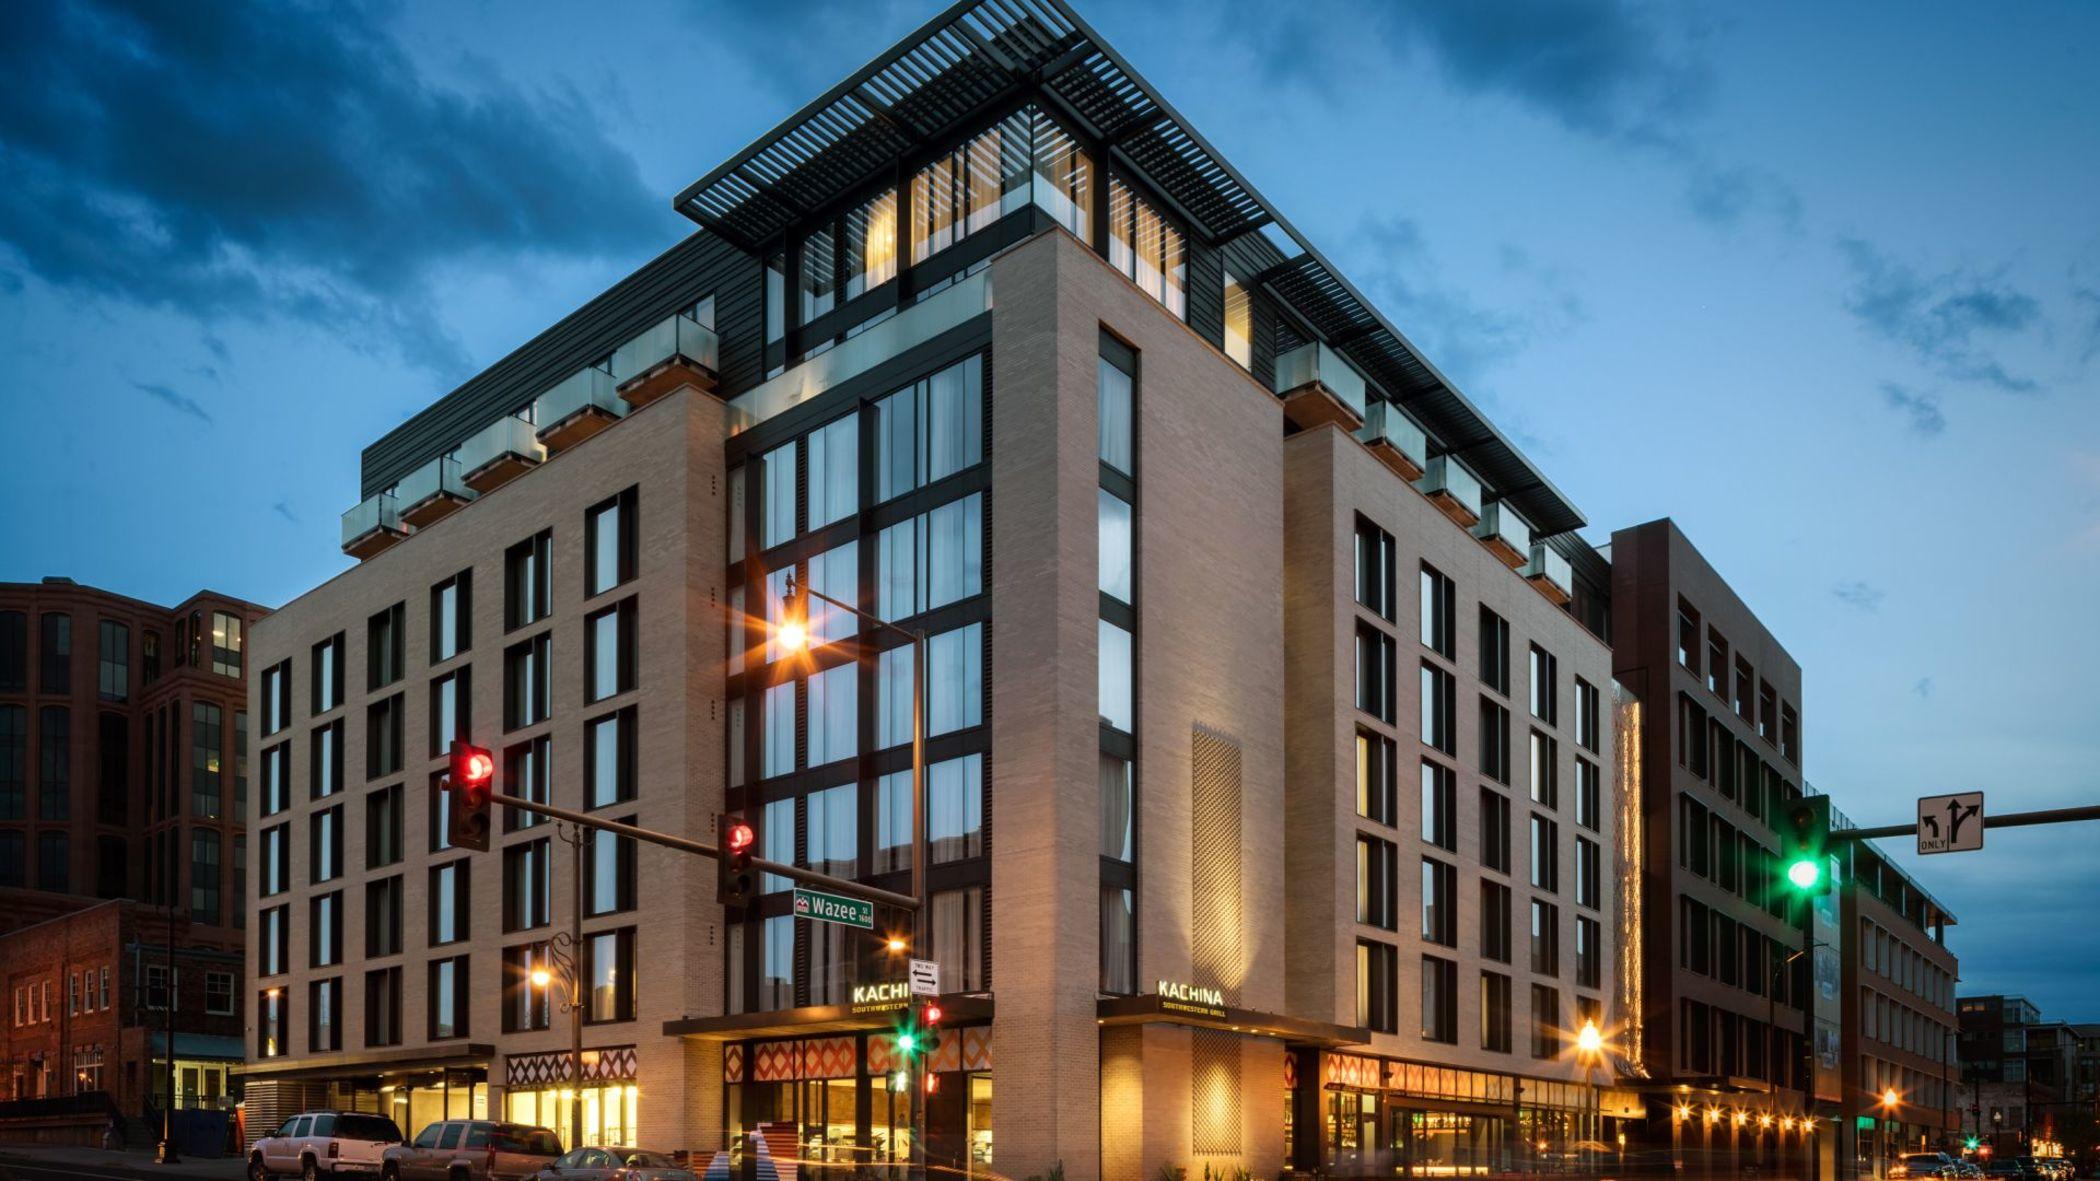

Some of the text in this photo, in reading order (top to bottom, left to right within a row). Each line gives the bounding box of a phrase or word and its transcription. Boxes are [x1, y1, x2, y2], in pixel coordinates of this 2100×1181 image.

[1921, 840, 1945, 849] ONLY
[812, 896, 856, 921] Wazee
[853, 982, 912, 1003] KACHI
[1159, 980, 1224, 1006] KACHINA
